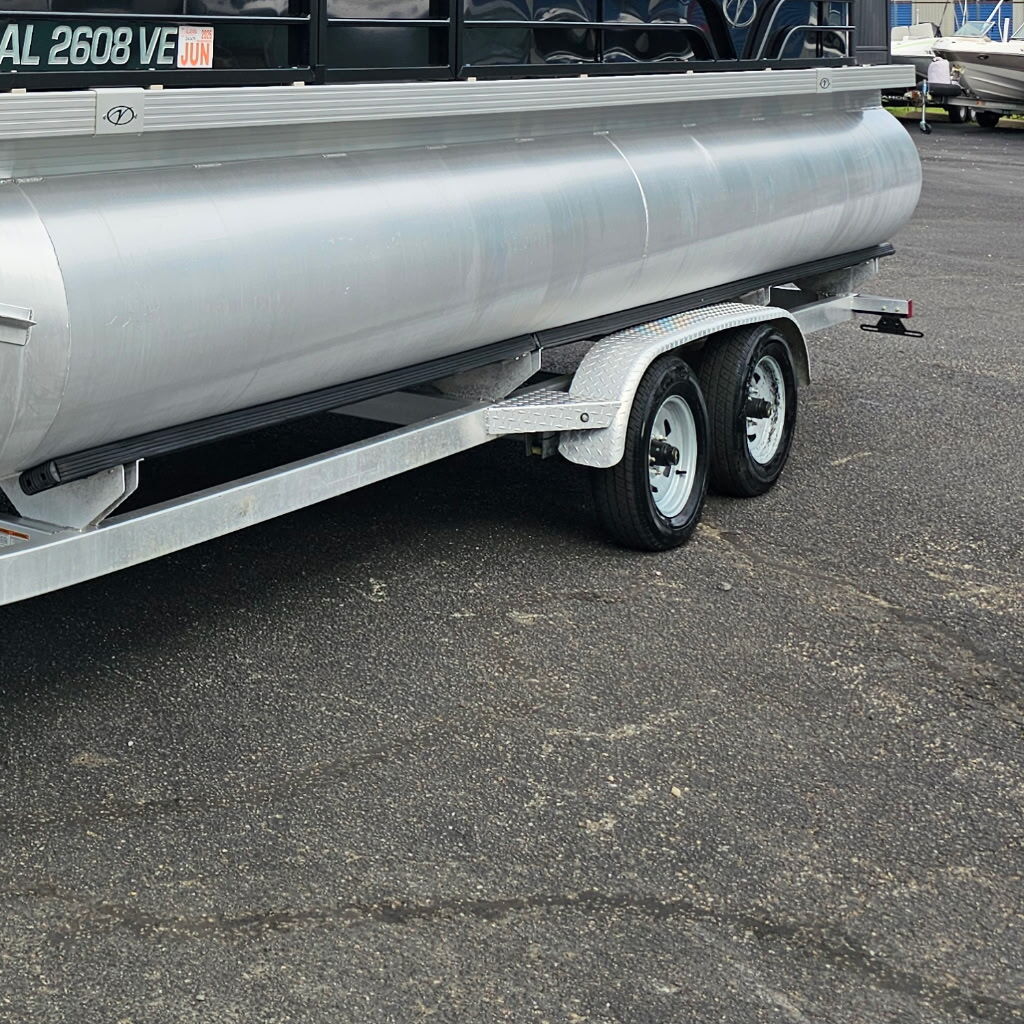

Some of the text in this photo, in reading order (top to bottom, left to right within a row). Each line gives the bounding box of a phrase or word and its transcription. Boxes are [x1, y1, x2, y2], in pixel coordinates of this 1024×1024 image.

[48, 25, 133, 65] 2608
[139, 26, 178, 65] VE
[180, 42, 210, 66] JUN
